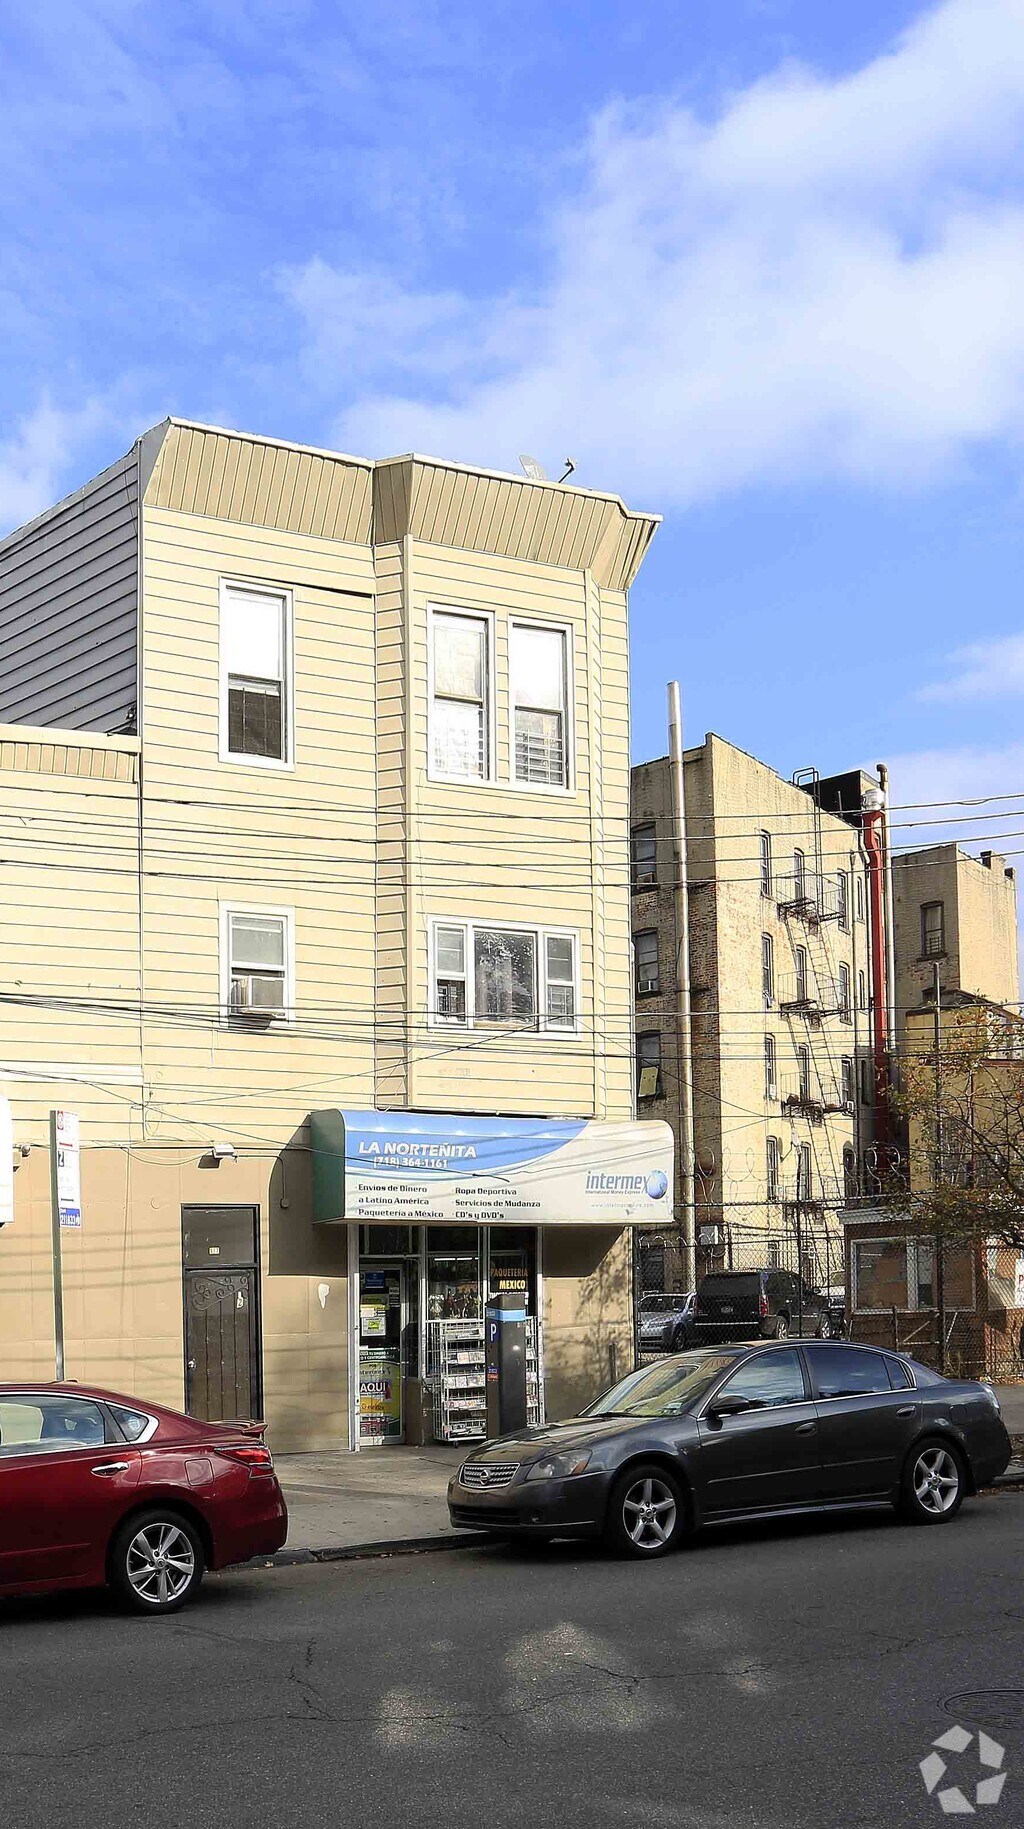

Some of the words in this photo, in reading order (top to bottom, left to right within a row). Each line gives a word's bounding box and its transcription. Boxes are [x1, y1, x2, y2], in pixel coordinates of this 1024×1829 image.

[358, 1141, 381, 1154] LA
[384, 1142, 477, 1158] NORTEÑITA
[374, 1156, 400, 1168] (718)
[402, 1158, 448, 1168] 364-1161
[586, 1171, 652, 1194] intermex
[387, 1184, 398, 1192] de
[399, 1184, 428, 1193] Dinero
[455, 1187, 476, 1195] Ropa
[477, 1187, 517, 1196] Deportiva
[365, 1196, 393, 1204] Latino
[455, 1199, 492, 1207] Servicios
[504, 1200, 541, 1208] Mudanza
[481, 1211, 505, 1219] DVD's
[499, 1280, 526, 1290] MEXICO
[360, 1382, 386, 1392] AQUI
